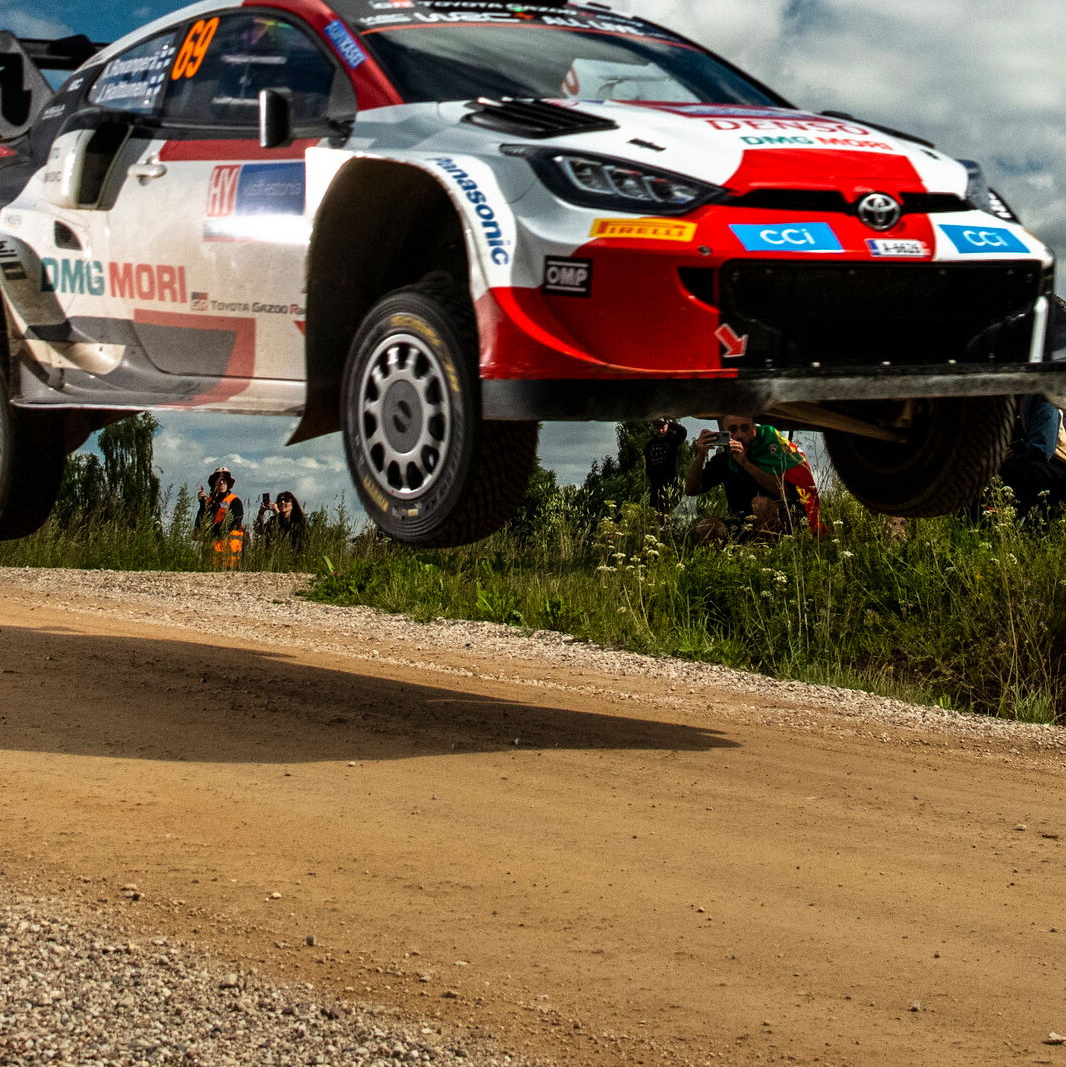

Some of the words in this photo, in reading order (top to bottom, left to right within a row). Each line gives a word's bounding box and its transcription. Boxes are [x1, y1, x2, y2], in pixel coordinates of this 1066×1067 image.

[171, 17, 220, 80] 69
[706, 120, 871, 135] DENSO
[740, 136, 814, 145] DMG
[815, 137, 894, 150] MORI
[428, 157, 510, 265] Panasonic
[600, 220, 687, 237] PIRELLI
[40, 257, 105, 296] DMG
[109, 262, 187, 303] MORI
[548, 267, 589, 285] OMP
